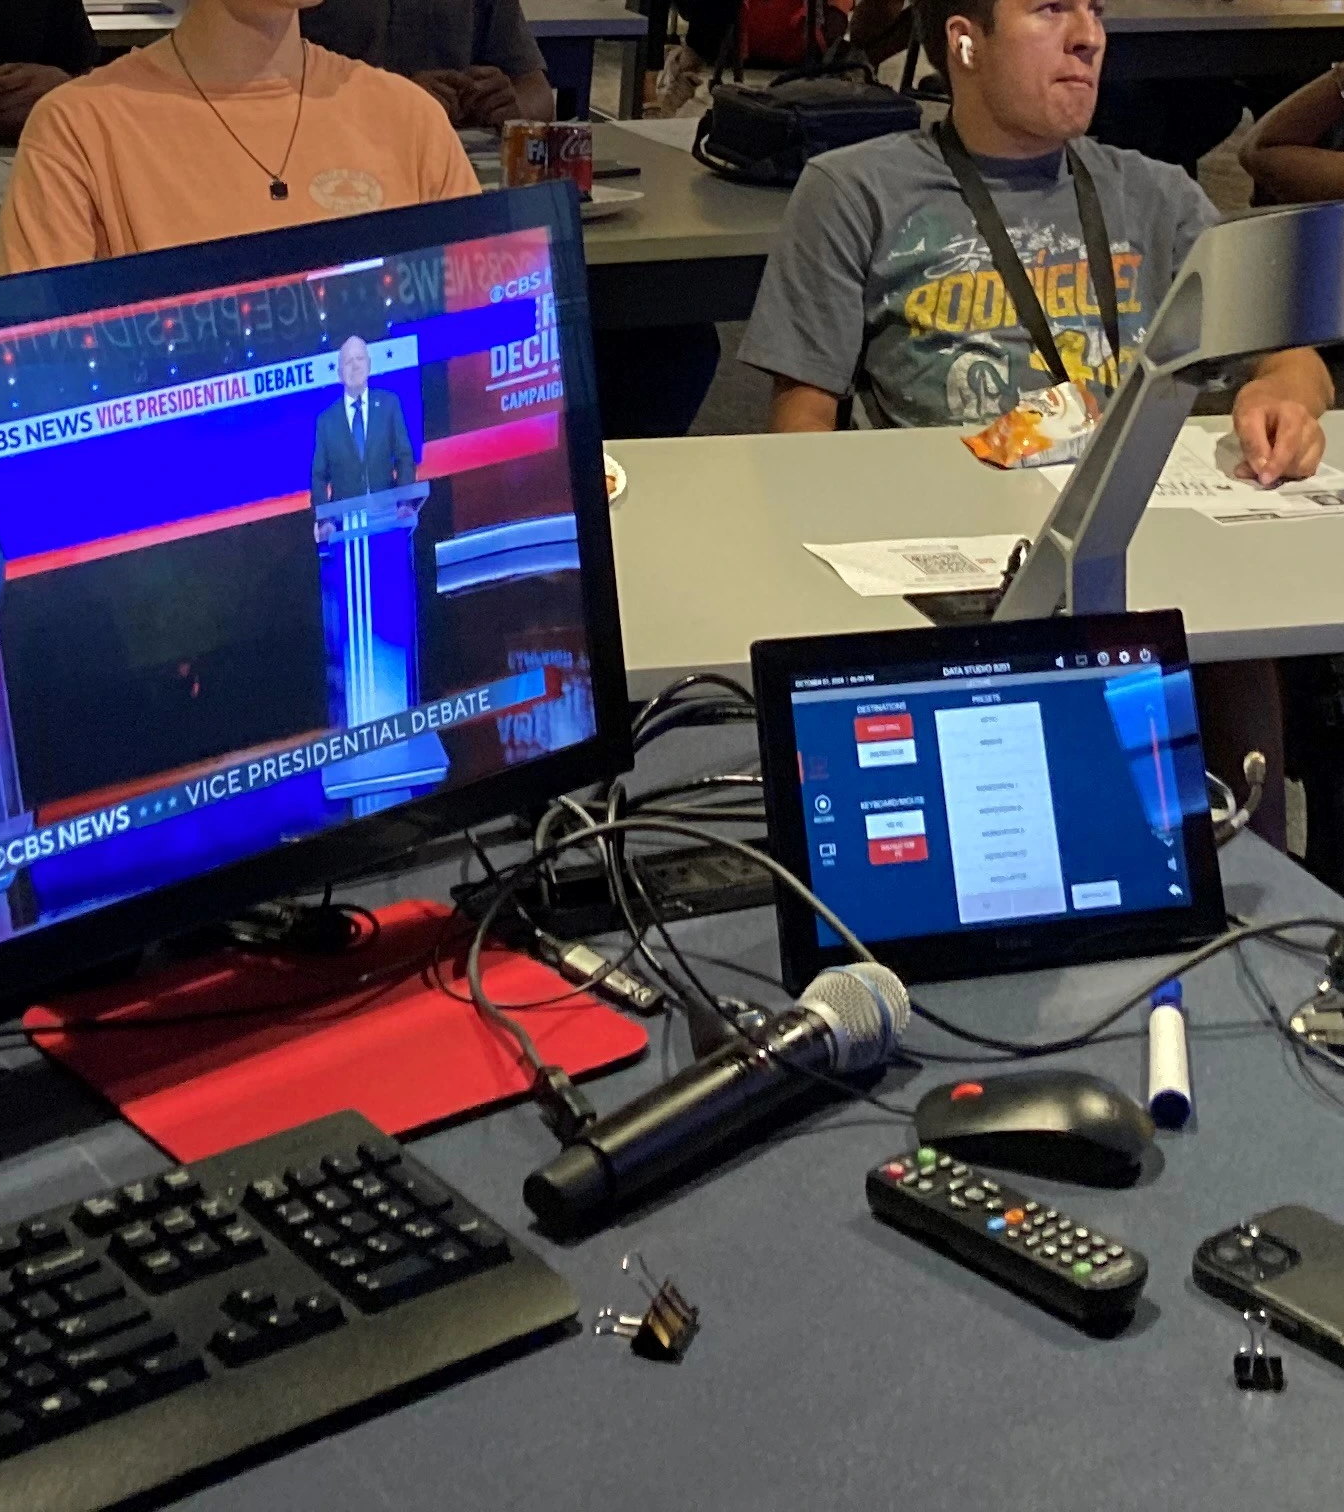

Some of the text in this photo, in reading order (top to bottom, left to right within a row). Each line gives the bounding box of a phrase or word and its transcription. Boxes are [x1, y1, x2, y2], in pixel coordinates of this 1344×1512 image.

[506, 271, 542, 300] CBS
[490, 327, 561, 379] DECI
[25, 411, 93, 447] NEWS
[96, 401, 134, 430] VICE
[136, 375, 252, 422] PRESIDENTIAL
[255, 361, 315, 395] DEBATE
[500, 379, 564, 412] CAMPAIG
[6, 830, 55, 865] CBS
[57, 805, 131, 850] NEWS
[184, 769, 242, 807] VICE
[247, 718, 407, 787] PRESIDENTIAL
[411, 688, 492, 733] DEBATE
